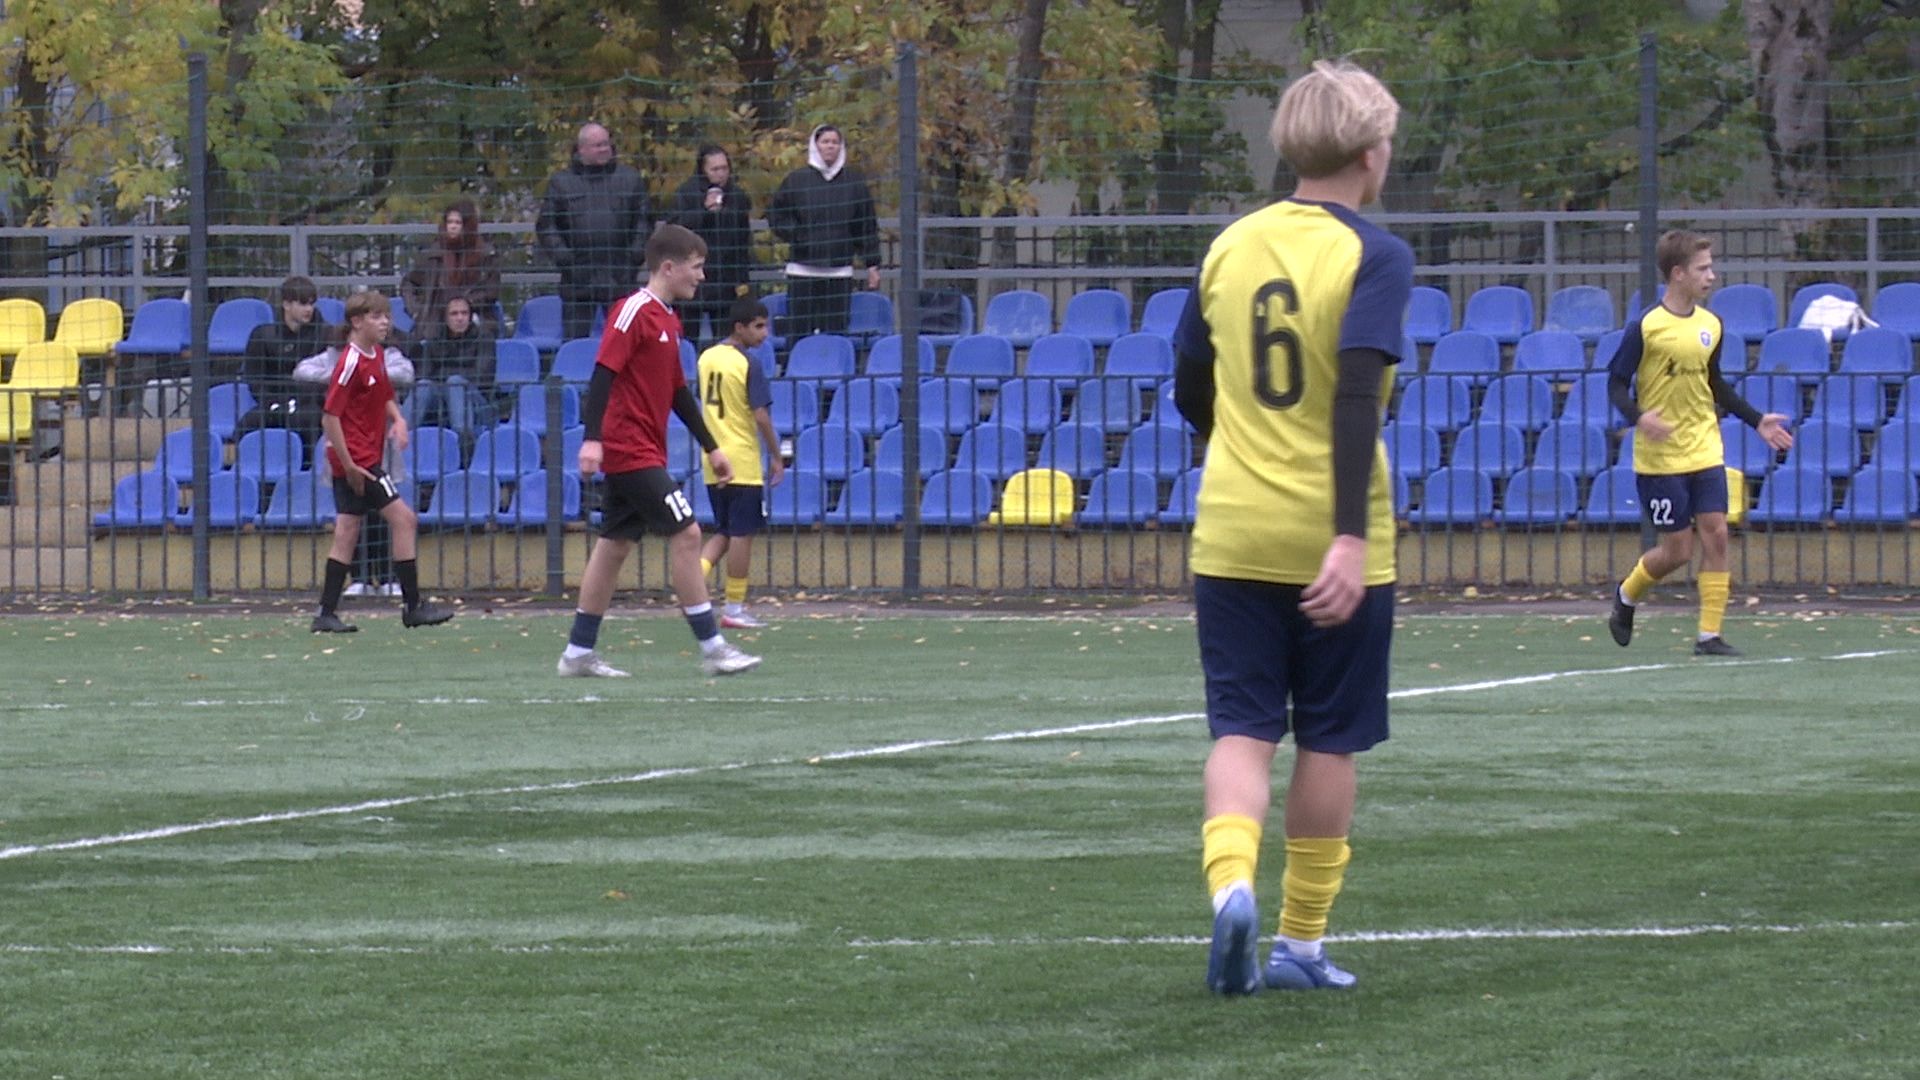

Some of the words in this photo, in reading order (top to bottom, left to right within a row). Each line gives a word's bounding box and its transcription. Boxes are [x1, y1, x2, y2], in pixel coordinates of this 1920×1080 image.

[1252, 279, 1303, 410] 6
[706, 371, 725, 420] 4
[664, 489, 693, 522] 15
[1650, 498, 1675, 525] 22
